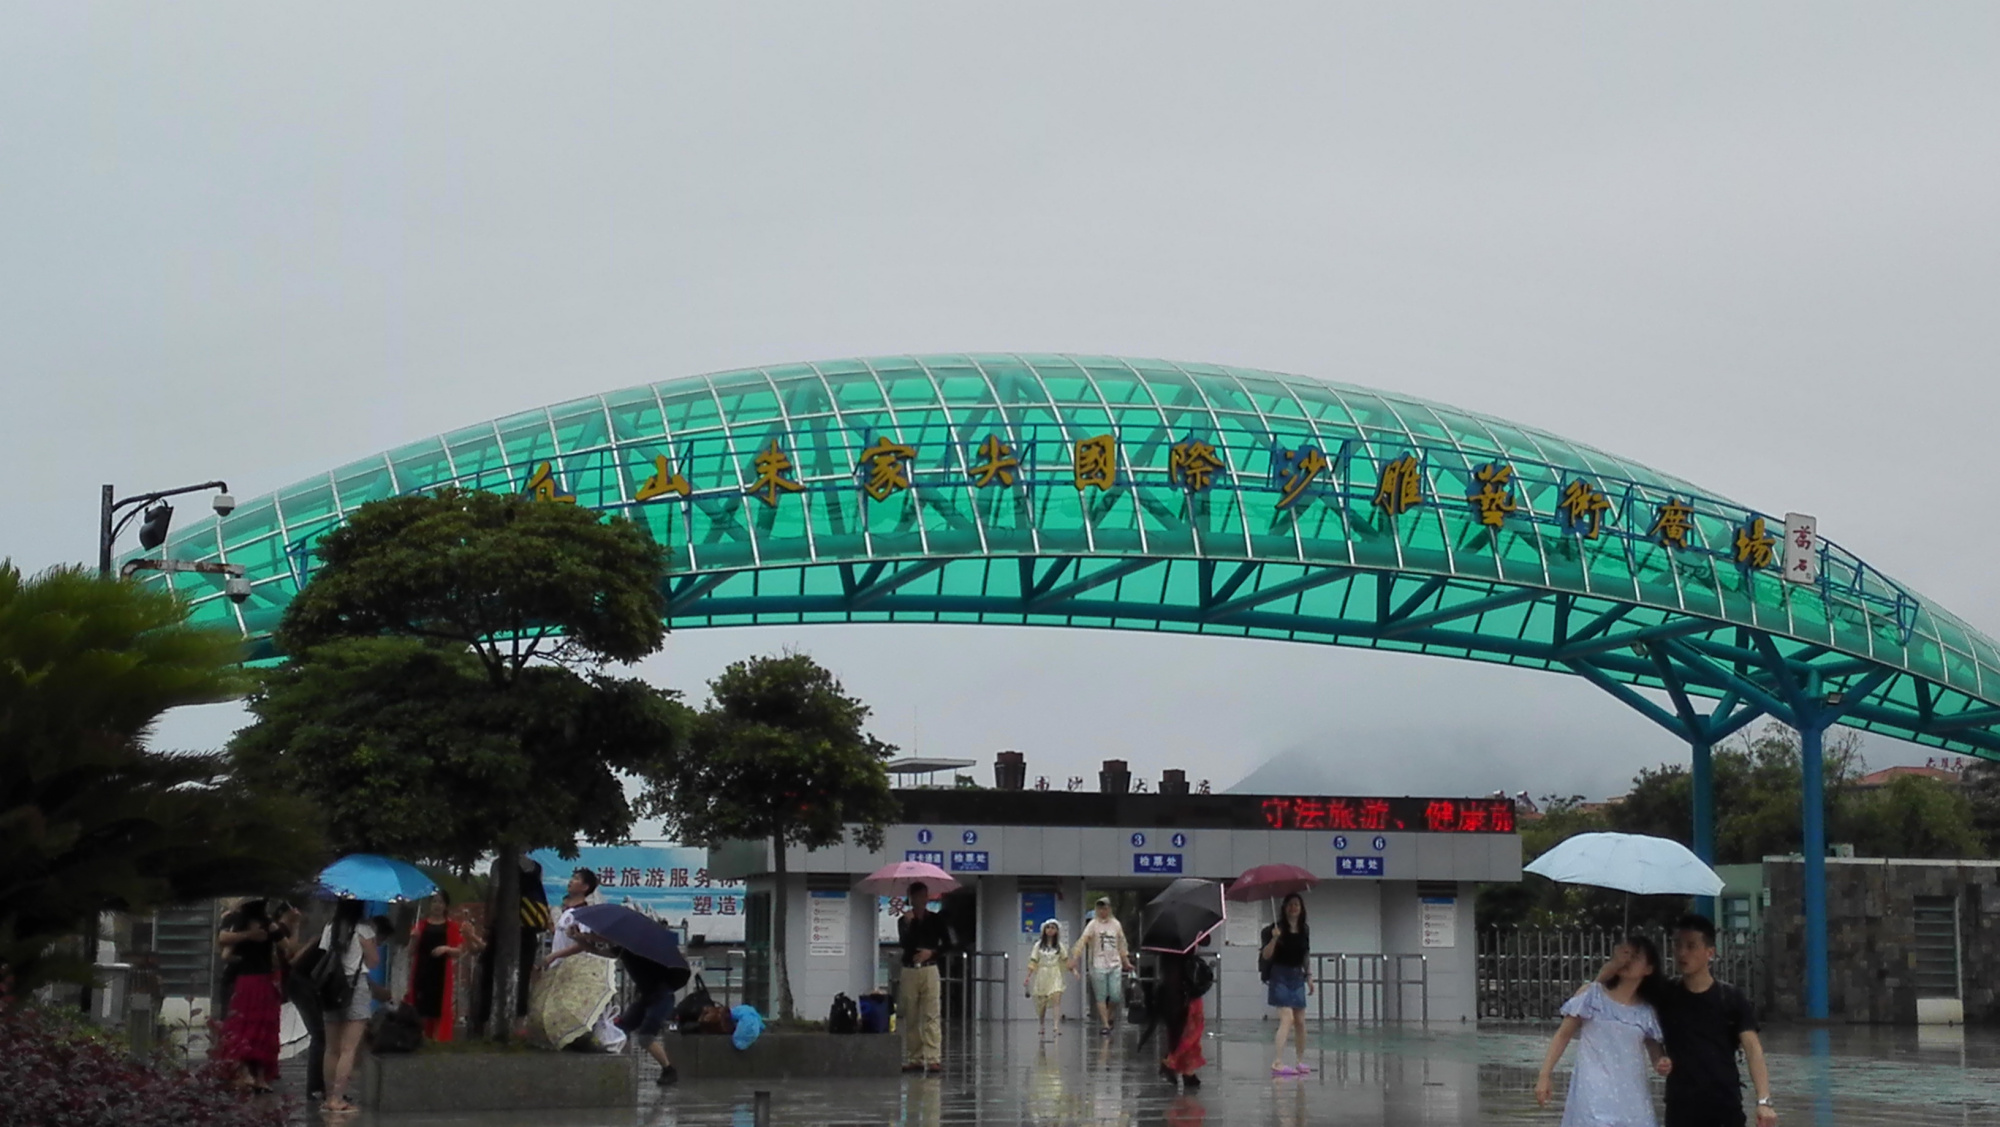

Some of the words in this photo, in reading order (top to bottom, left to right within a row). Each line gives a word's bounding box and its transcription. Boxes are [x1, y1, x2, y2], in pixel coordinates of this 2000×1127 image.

[953, 853, 986, 863] 检票处
[1139, 856, 1177, 867] 检票处
[1342, 858, 1378, 869] 检票处
[573, 867, 747, 888] 进旅游服务
[692, 896, 747, 915] 塑造
